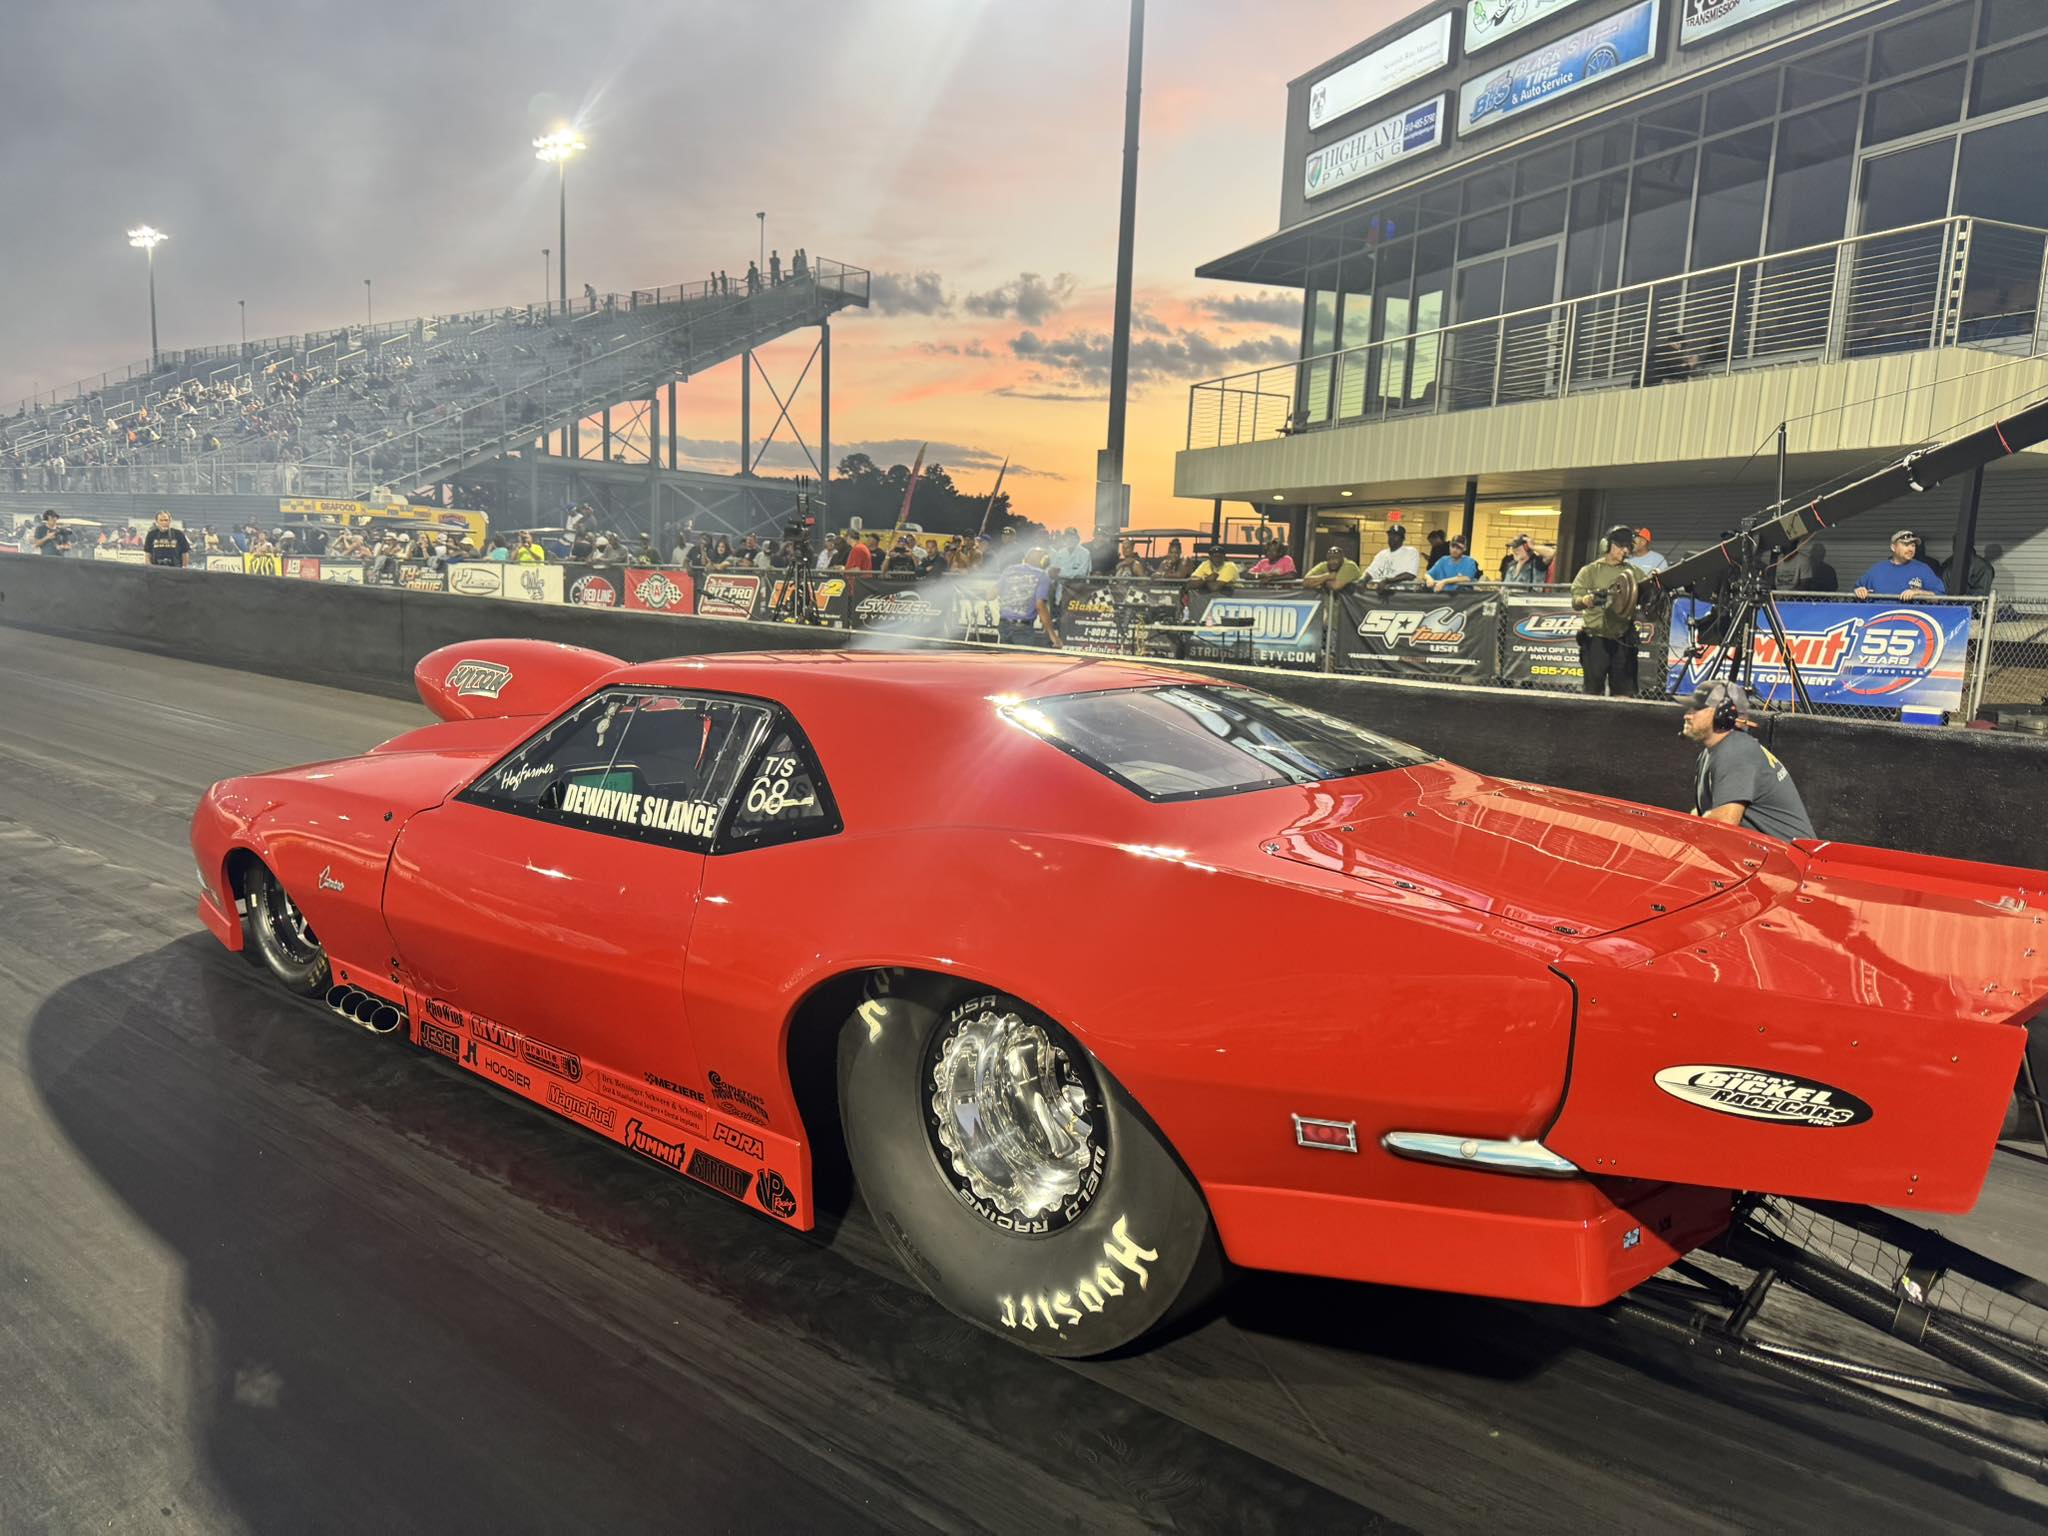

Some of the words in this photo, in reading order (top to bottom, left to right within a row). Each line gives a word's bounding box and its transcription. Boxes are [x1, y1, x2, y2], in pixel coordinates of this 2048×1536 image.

[1511, 95, 1519, 105] &
[1520, 84, 1541, 102] Auto
[1541, 72, 1573, 94] Service
[1526, 61, 1561, 88] TIRE
[1324, 119, 1403, 169] HIGHLAND
[1322, 142, 1401, 184] PAVING
[583, 588, 597, 602] RED
[597, 588, 612, 603] LINE
[858, 599, 934, 615] SWITZER
[1430, 645, 1459, 653] USA
[1530, 654, 1563, 662] PAYING
[1861, 629, 1919, 656] 55
[1858, 655, 1910, 665] YEARS
[765, 756, 796, 777] T/S
[562, 784, 642, 824] DEWAYNE
[641, 797, 718, 839] SILANCE
[747, 776, 789, 815] 68
[952, 995, 997, 1022] USA
[421, 1023, 459, 1055] JESEL
[472, 1017, 516, 1053] MVM
[525, 1042, 557, 1062] braille
[485, 1057, 531, 1090] HOOSIER
[655, 1076, 706, 1103] MEZIERE
[1694, 1072, 1833, 1106] BICKEL
[1730, 1072, 1795, 1085] JERRY
[548, 1084, 616, 1129] MagnaFuel
[1711, 1088, 1777, 1111] RACE
[1777, 1098, 1854, 1122] CARS
[713, 1122, 764, 1161] PDRA
[694, 1152, 744, 1198] STROUD
[757, 1168, 785, 1212] VP
[1065, 1145, 1106, 1222] WELD
[959, 1189, 1049, 1234] RACING
[1000, 1213, 1159, 1341] Hoosier
